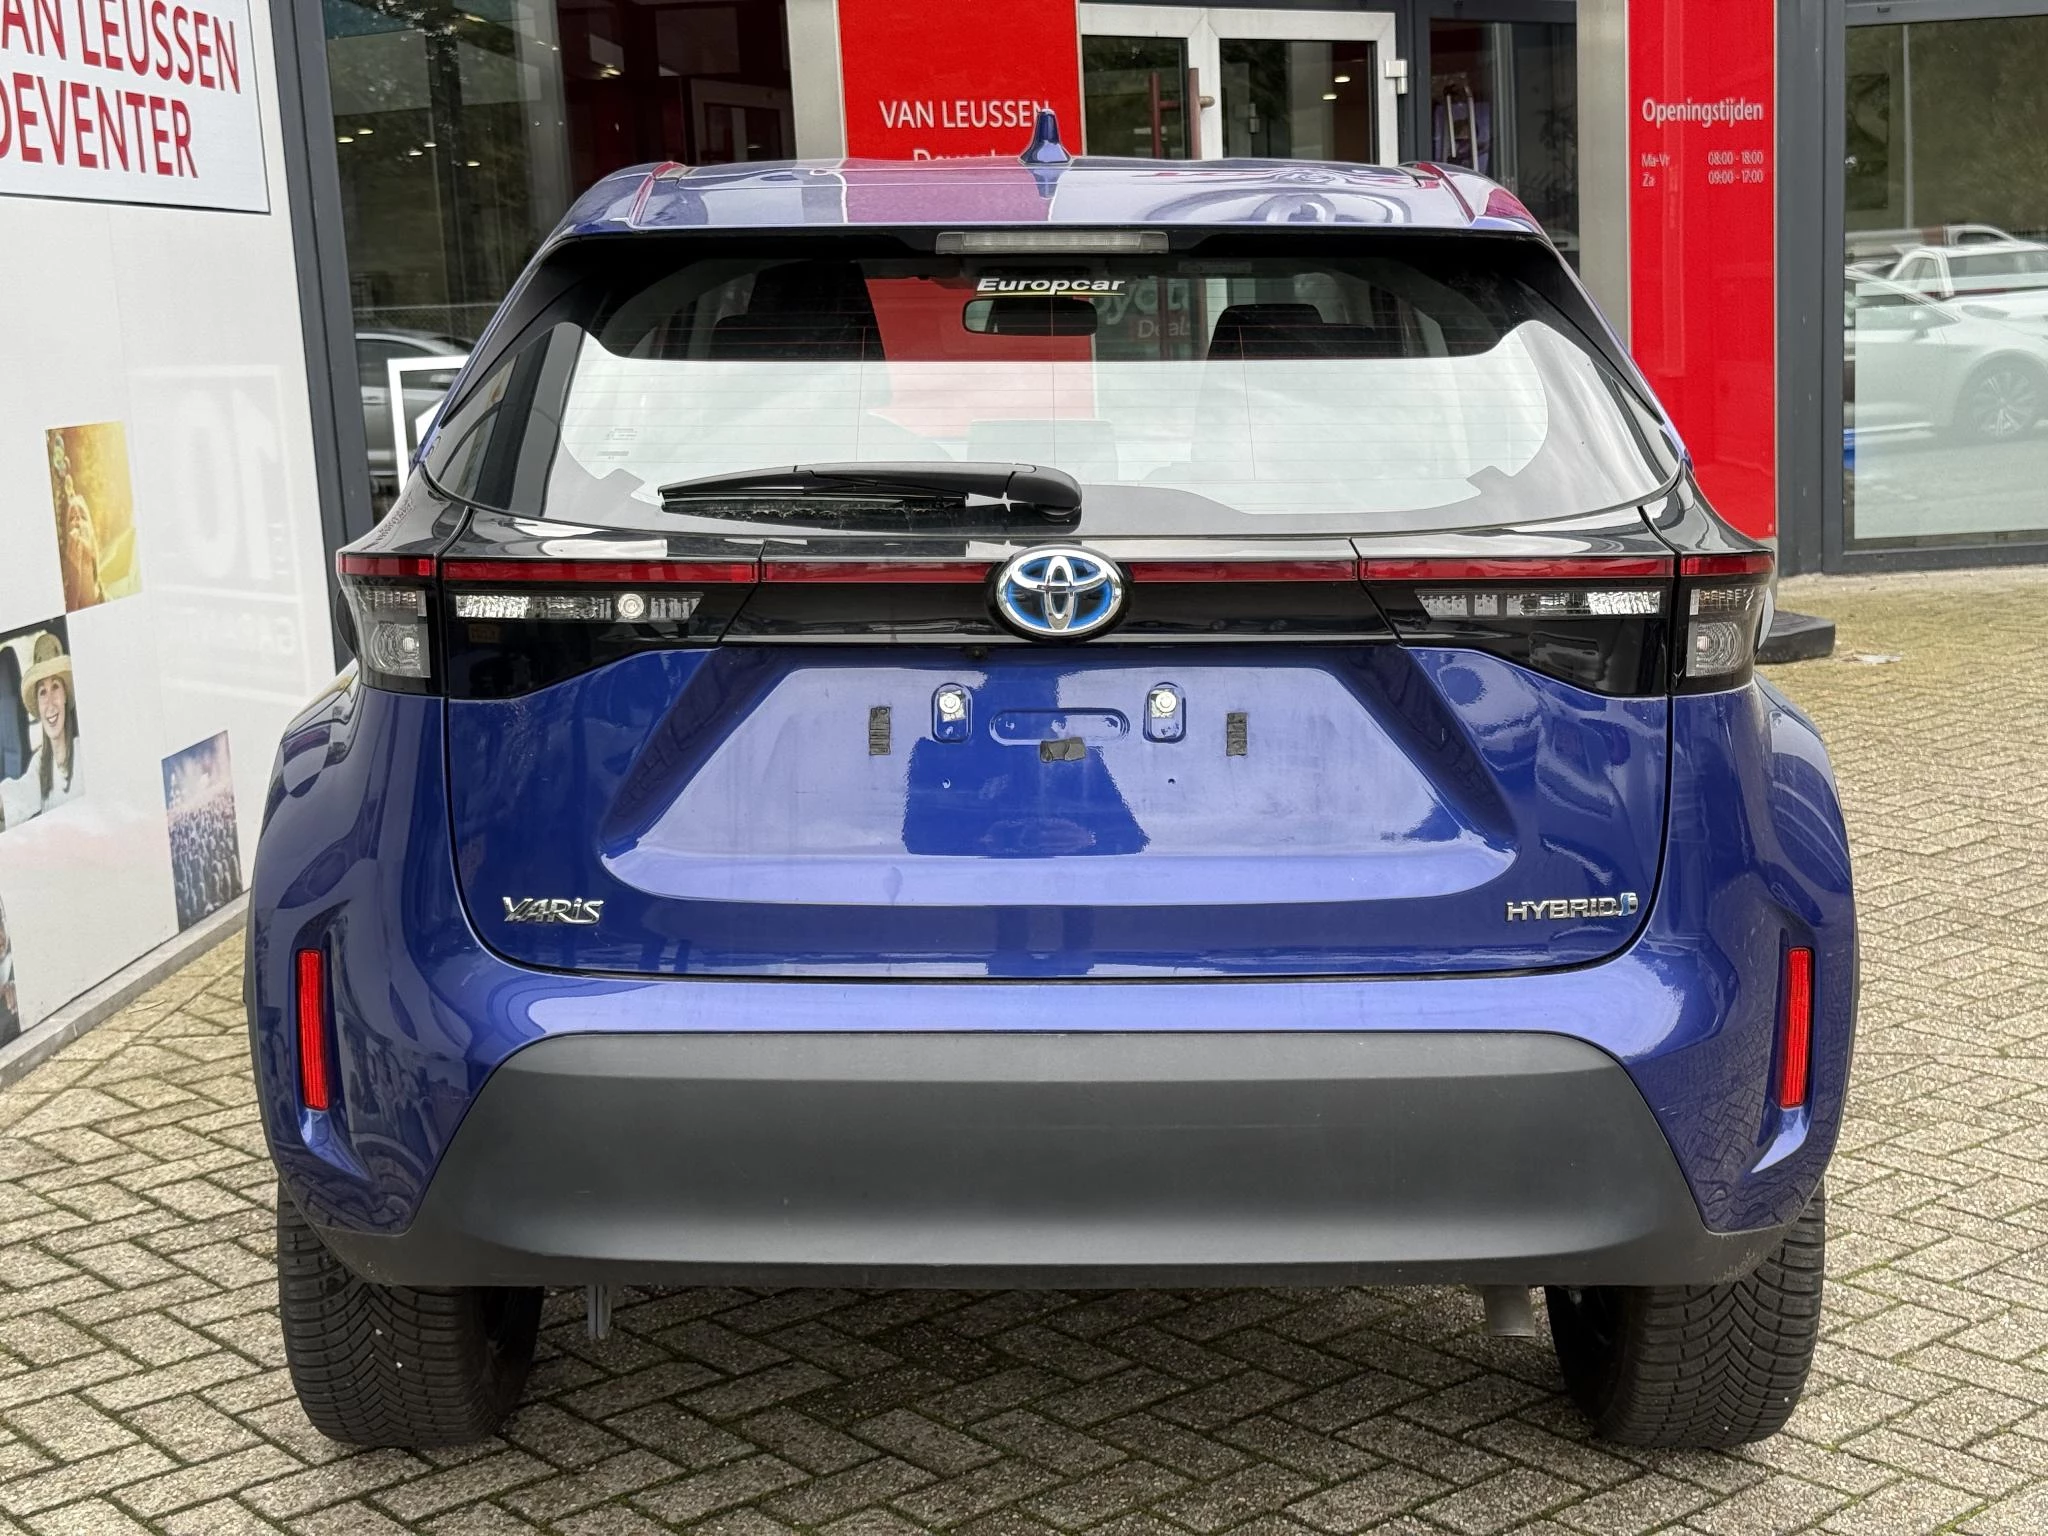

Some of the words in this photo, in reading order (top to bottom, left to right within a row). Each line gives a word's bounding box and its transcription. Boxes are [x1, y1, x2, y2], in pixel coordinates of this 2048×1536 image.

[1, 0, 67, 60] AN
[77, 0, 241, 94] LEUSSEN
[878, 100, 935, 129] VAN
[1641, 98, 1764, 128] Openingstijden
[1641, 152, 1670, 168] Ma-Vr
[1708, 150, 1734, 166] 08:00
[1741, 150, 1764, 165] 18:00
[1642, 172, 1656, 187] Za
[1708, 169, 1734, 185] 09:00
[976, 277, 1126, 295] Europcar
[1506, 897, 1617, 922] HYBRID
